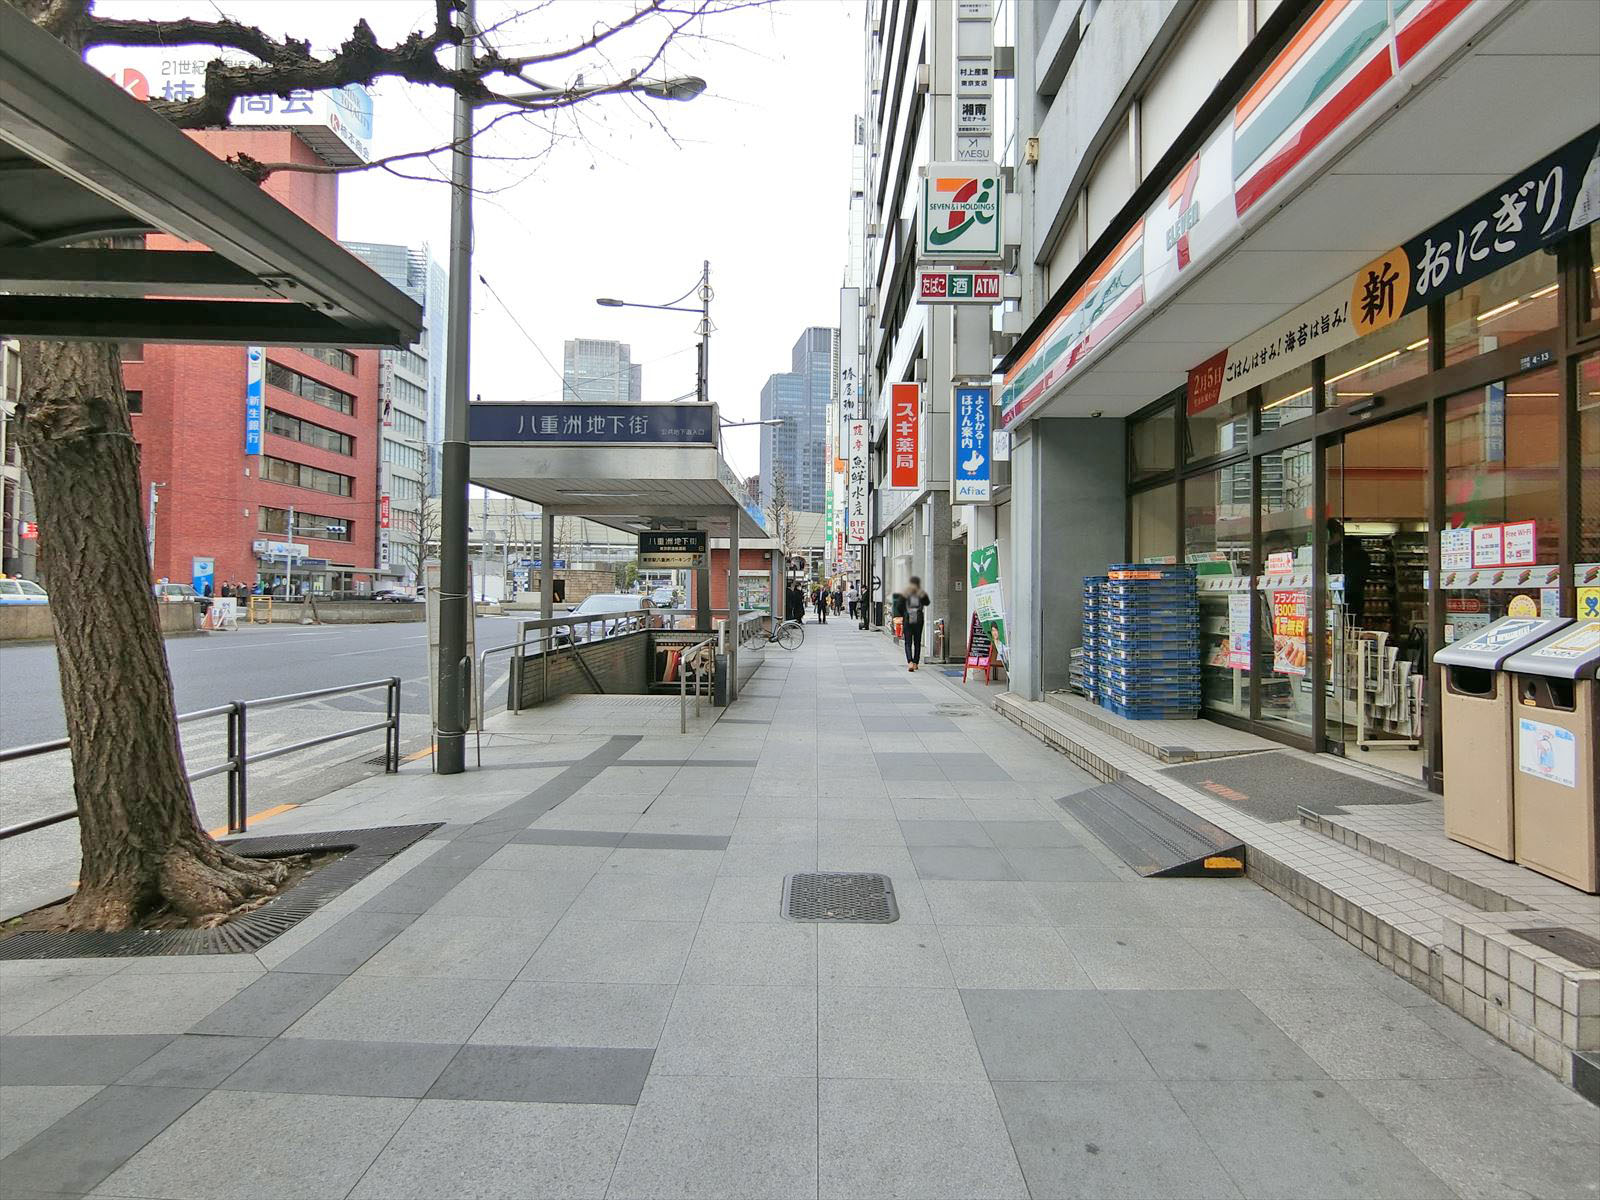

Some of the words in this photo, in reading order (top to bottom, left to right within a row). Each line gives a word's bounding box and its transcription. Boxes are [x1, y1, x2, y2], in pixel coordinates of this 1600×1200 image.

[960, 68, 988, 77] 村上産業
[962, 103, 987, 116] 湘南
[958, 149, 989, 158] YAESU
[960, 202, 995, 211] HOLDINGS
[1415, 165, 1564, 296] おにぎり
[922, 277, 946, 294] たばこ
[952, 277, 969, 294] 酒
[975, 278, 998, 294] ATM
[1360, 261, 1400, 327] 新
[1284, 300, 1349, 355] 海苔は旨み!
[1532, 352, 1550, 364] 4-13
[1193, 365, 1223, 396] 2月5日
[248, 395, 260, 444] 新生銀行
[517, 414, 649, 435] 八重洲地下街
[961, 395, 973, 449] ほけん案内
[974, 395, 985, 449] よくわかる!
[896, 402, 916, 469] スギ薬局
[850, 520, 866, 528] B1F
[851, 527, 865, 535] 入口
[649, 537, 698, 546] 八重洲地下街
